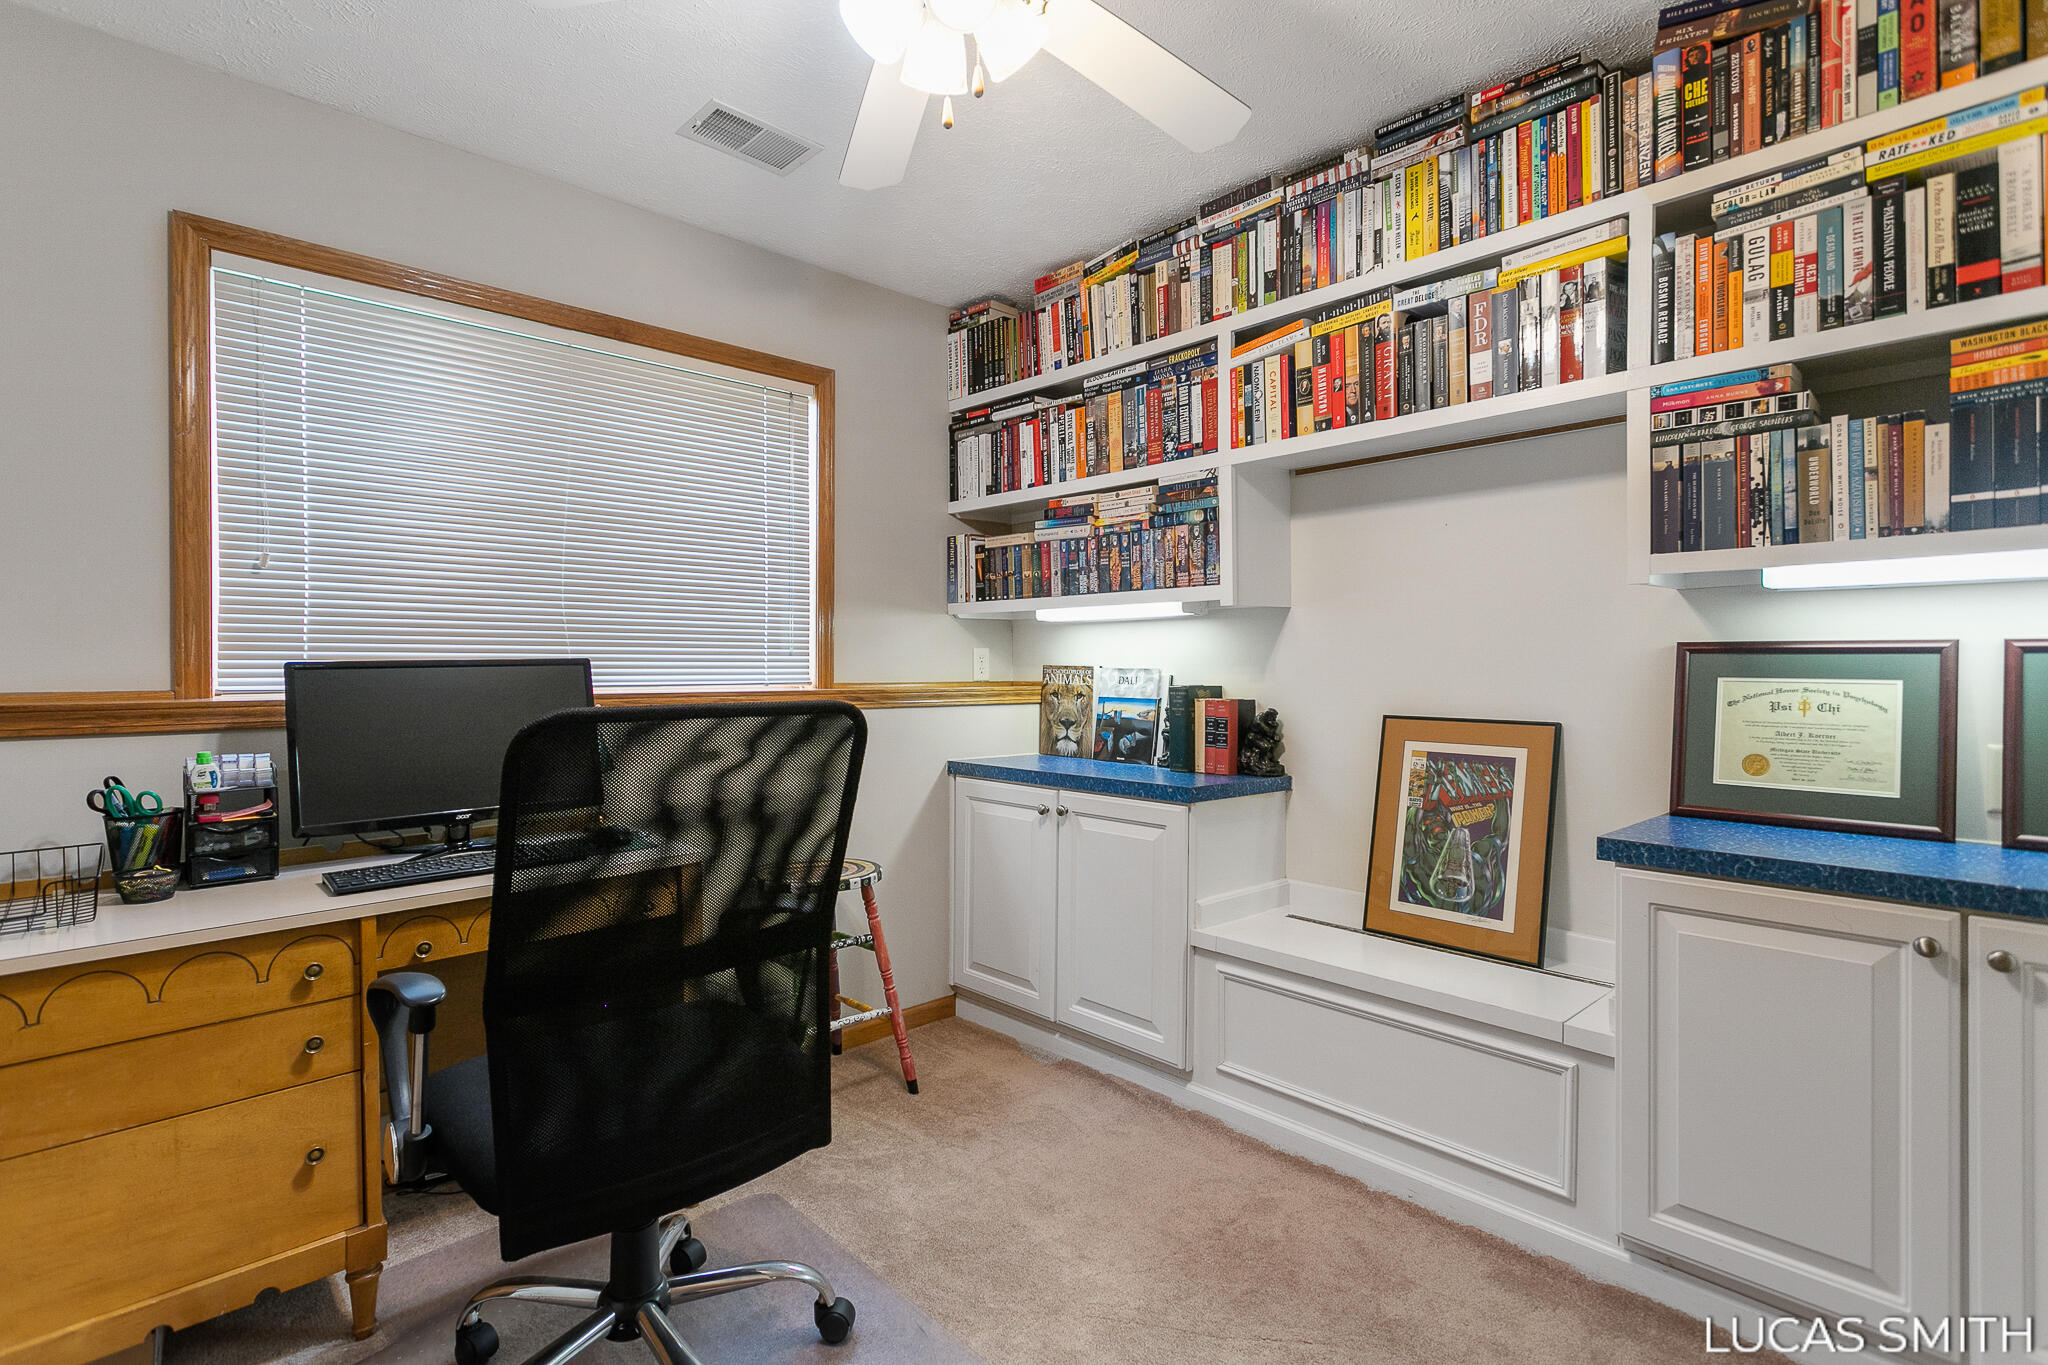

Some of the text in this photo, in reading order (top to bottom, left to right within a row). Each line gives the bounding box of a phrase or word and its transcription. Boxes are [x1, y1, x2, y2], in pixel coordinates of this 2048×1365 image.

[1659, 28, 1709, 46] FRIGATES
[1676, 24, 1693, 35] SIX
[1732, 52, 1740, 94] ZEITOUN
[1495, 91, 1531, 108] UNBROKEN
[1684, 77, 1708, 100] CHE
[1388, 116, 1414, 130] DEMOCRACIES
[1426, 117, 1442, 128] CALLED
[1638, 78, 1651, 179] Purity FRANZEN
[1658, 74, 1677, 163] JONATHAN FRANZEN
[1871, 122, 1943, 150] ON THE MOVE
[1728, 177, 1775, 196] THE RETURN
[1210, 194, 1272, 223] INFINITE GAME SIMON SINEK
[1440, 179, 1451, 219] MIDDLESEX
[1723, 187, 1776, 210] COLOR LAW
[1730, 212, 1763, 225] FORTRESS
[1738, 207, 1764, 218] WINTER
[1934, 188, 1944, 265] Peace End All Peace
[1960, 221, 1994, 235] WORLD
[1826, 234, 1836, 271] DEAD HAND
[1852, 211, 1865, 272] THE LAST EMPIRE
[1883, 207, 1895, 292] PALESTINIAN PEOPLE
[1748, 236, 1766, 282] GULAG
[1794, 258, 1805, 294] FAMINE
[1806, 264, 1817, 282] RED
[1398, 292, 1434, 307] GREAT DELUGE
[1699, 242, 1708, 352] DAVID ENDGAME
[1716, 281, 1729, 319] YUGOSLAVIA
[1658, 276, 1668, 344] BOSNIA REMADE
[1473, 303, 1488, 347] FDR
[1960, 324, 2048, 348] WASHINGTON BLACK
[1169, 348, 1201, 363] FRACKOPOLY
[1107, 369, 1126, 378] EARTH
[1153, 372, 1174, 381] MONEY
[1383, 346, 1392, 399] GRANT
[1318, 367, 1328, 413] WASHINGTON
[1726, 390, 1748, 398] BURNS
[1178, 386, 1190, 443] GRAND EXPECTATIONS
[1662, 399, 1691, 407] Milkman
[1730, 415, 1794, 432] GEORGE SAUNDERS
[1655, 430, 1686, 443] LINCOLN
[1808, 456, 1818, 505] UNDERWORLD
[1044, 673, 1092, 686] ANIMALS
[1727, 699, 1741, 708] The
[1742, 690, 1773, 702] National
[1802, 687, 1830, 696] Society
[1843, 691, 1888, 714] Psychology
[1768, 700, 1841, 715] Psi Chi
